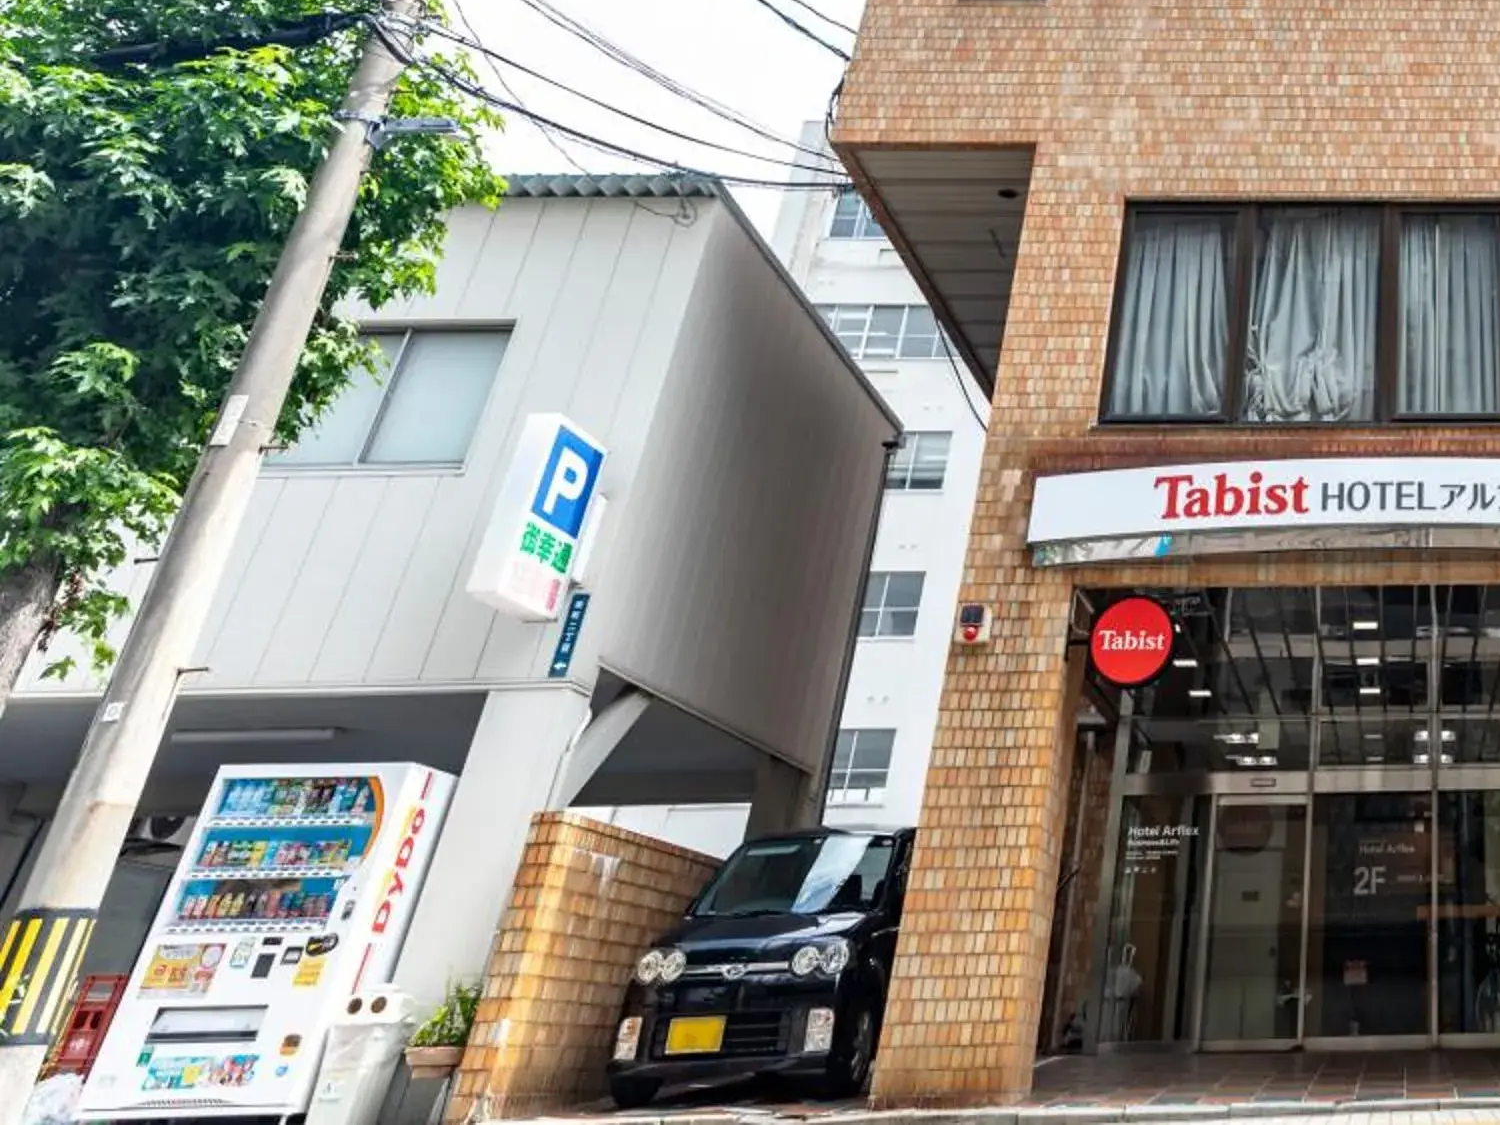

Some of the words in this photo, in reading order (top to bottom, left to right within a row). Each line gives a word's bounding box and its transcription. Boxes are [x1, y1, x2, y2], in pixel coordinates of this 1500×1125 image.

[542, 446, 589, 515] P
[1154, 470, 1310, 520] Tabist
[1098, 630, 1166, 651] Tabist
[1353, 866, 1387, 896] 2F
